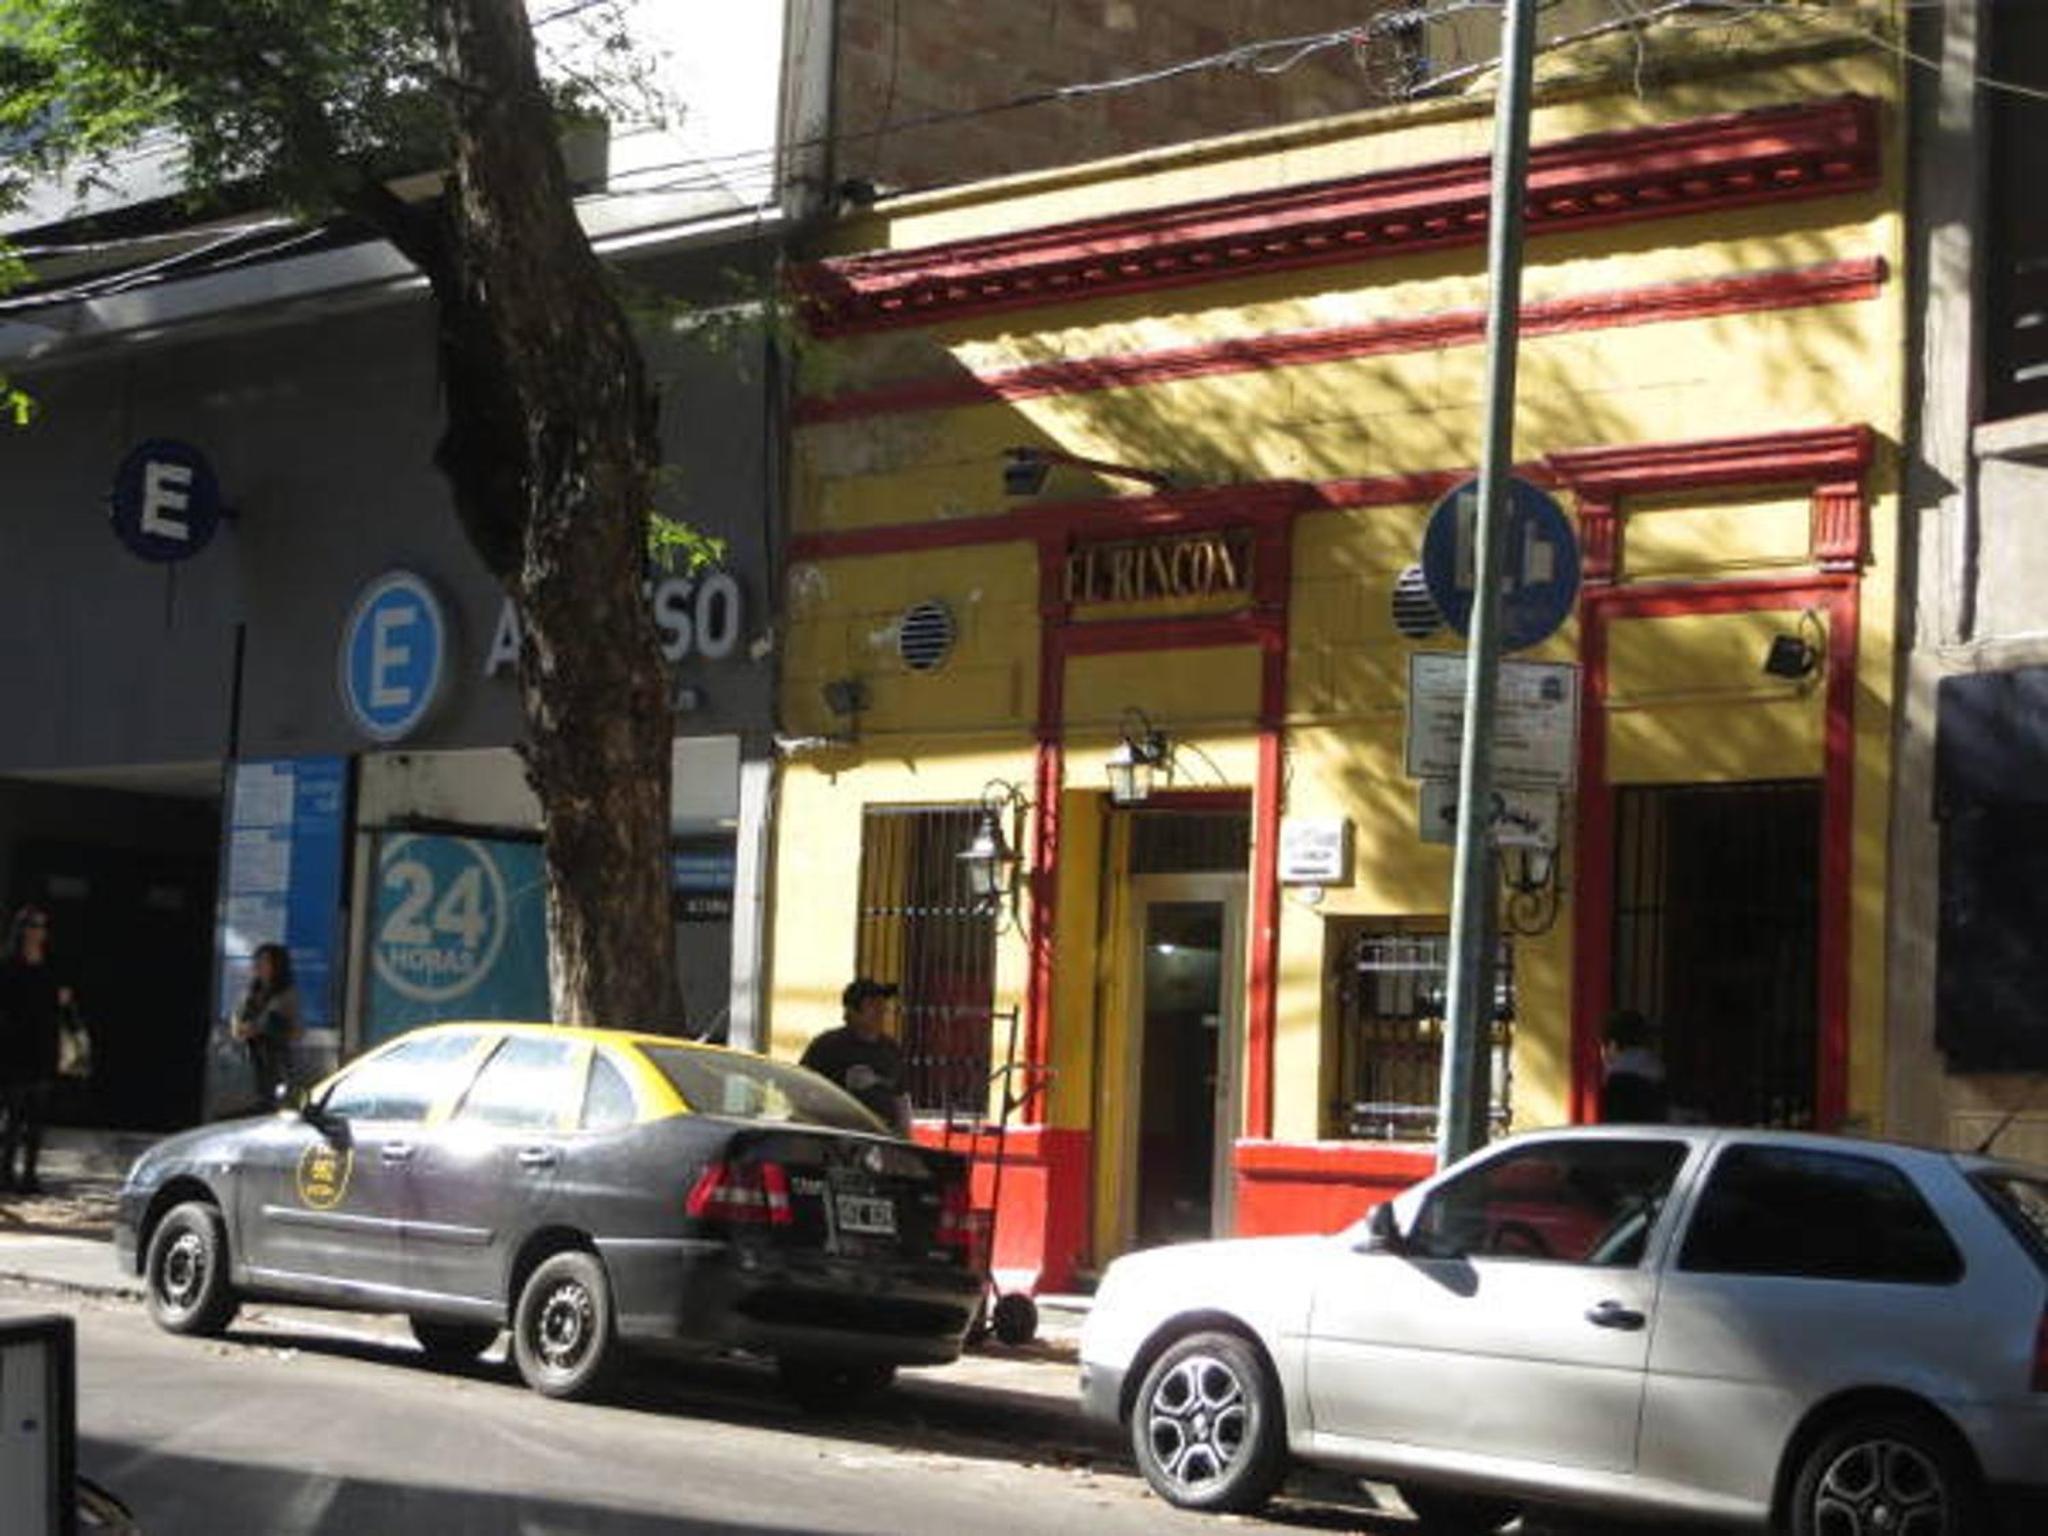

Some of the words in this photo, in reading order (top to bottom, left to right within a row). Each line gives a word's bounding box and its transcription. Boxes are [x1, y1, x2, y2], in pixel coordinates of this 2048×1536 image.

[141, 459, 193, 540] E
[370, 606, 418, 708] E
[381, 861, 487, 949] 24
